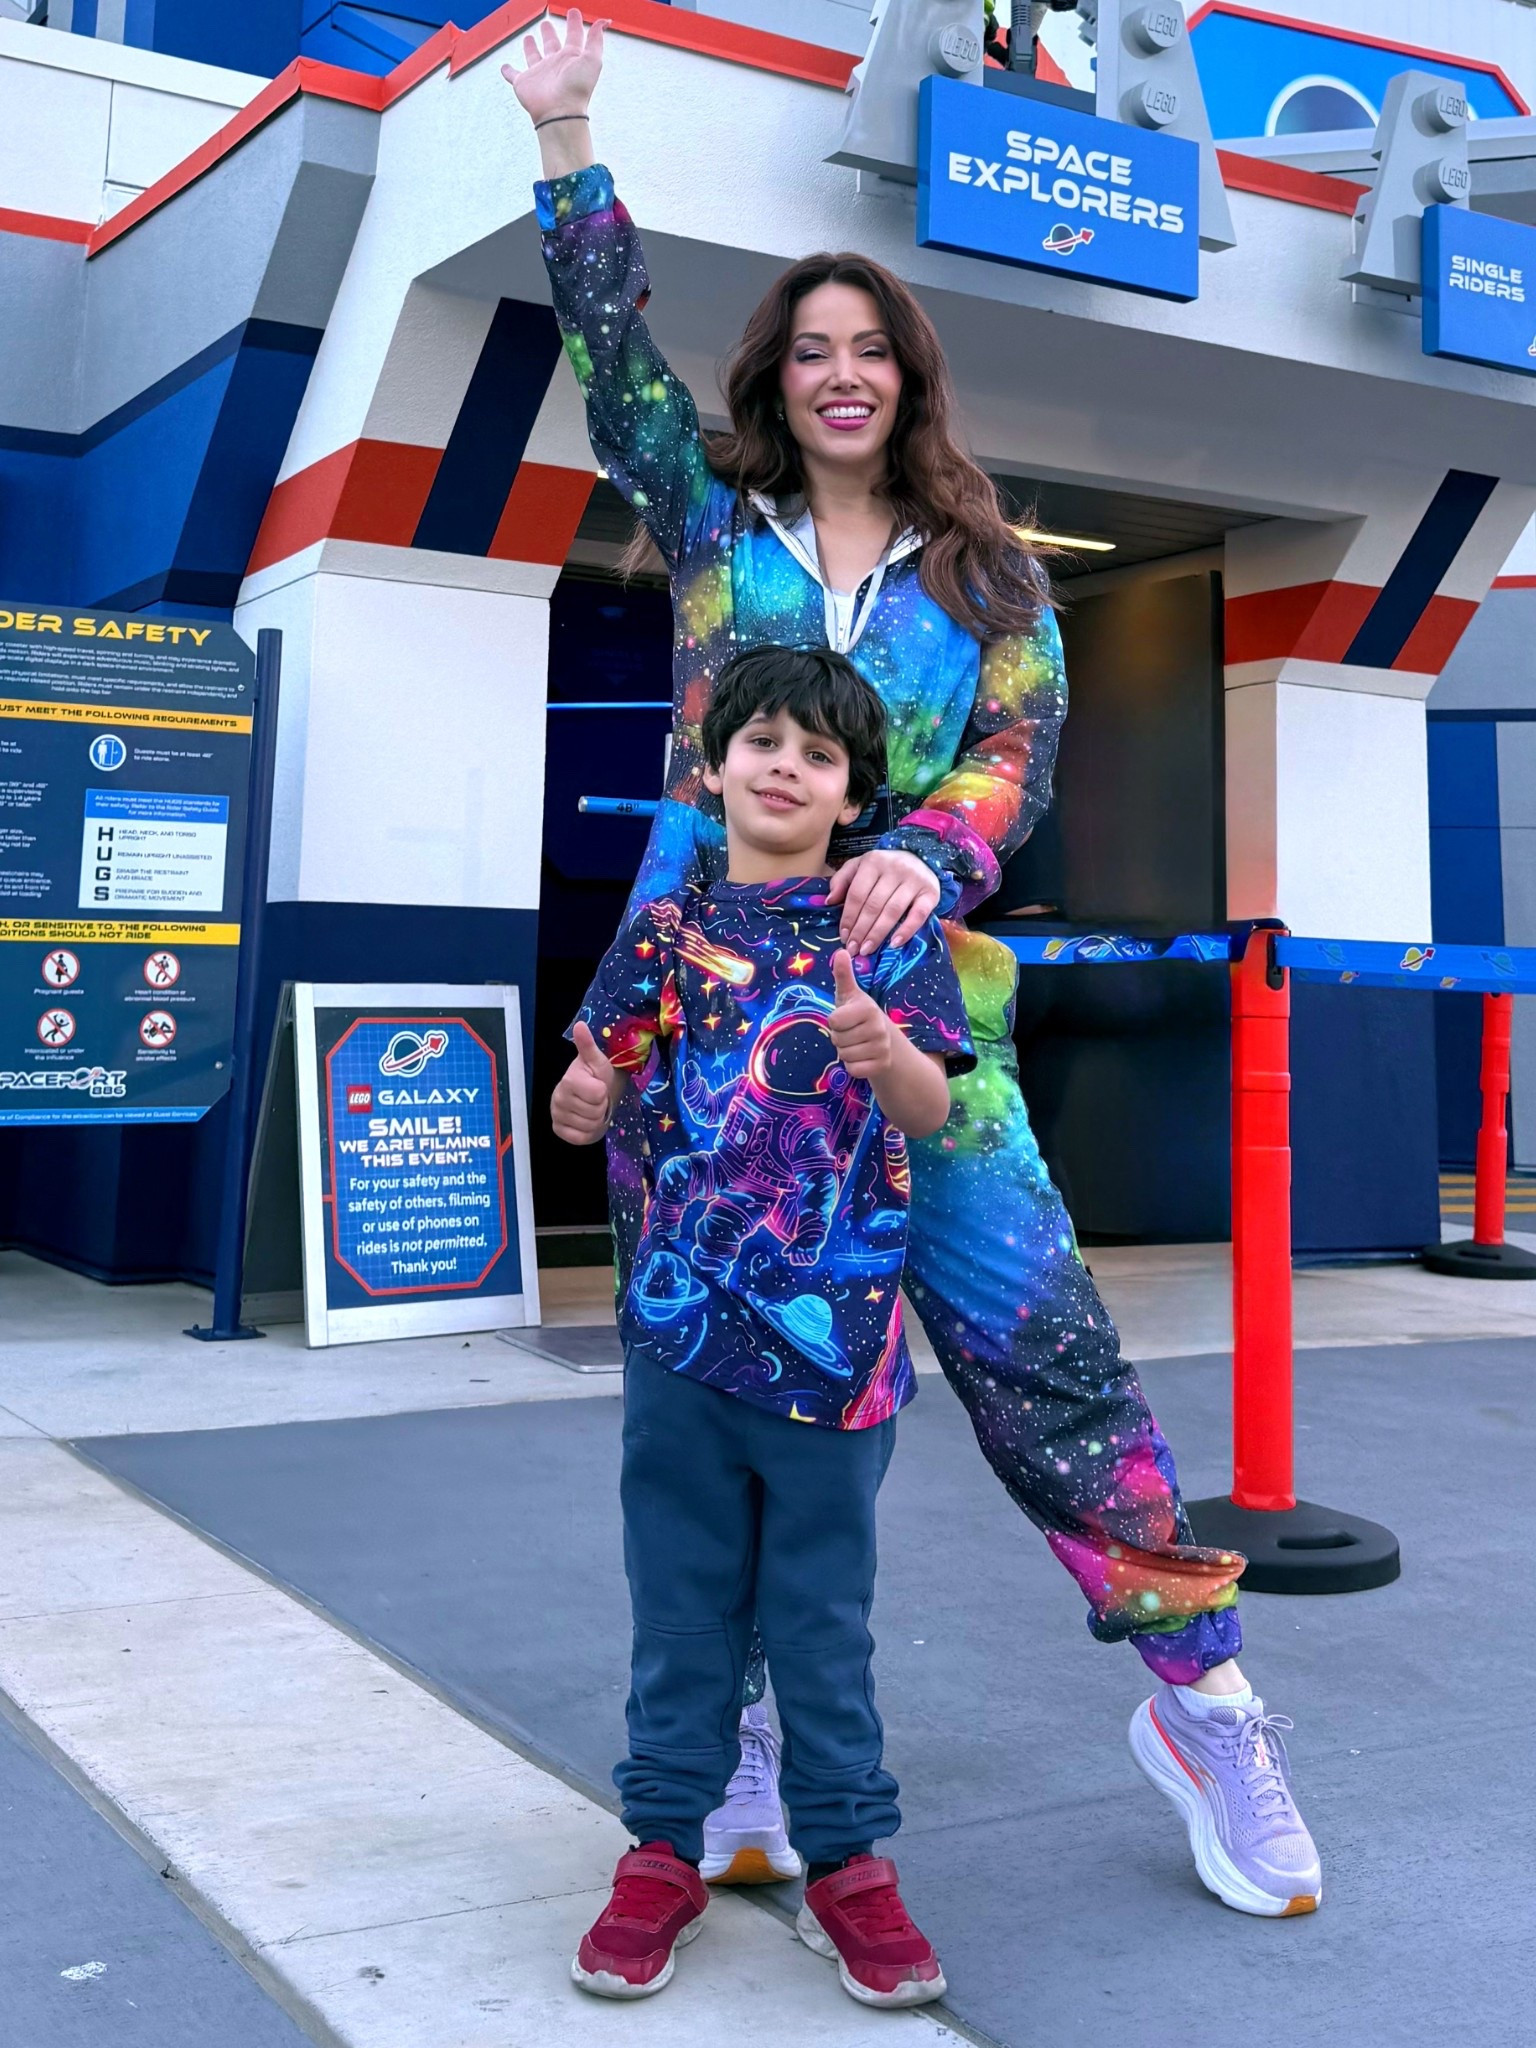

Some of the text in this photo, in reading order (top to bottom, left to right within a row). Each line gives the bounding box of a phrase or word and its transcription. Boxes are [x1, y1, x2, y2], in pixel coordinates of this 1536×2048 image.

[1148, 12, 1177, 38] LEGO
[943, 35, 979, 63] LEGO
[1146, 87, 1176, 115] LEGO
[1440, 94, 1466, 118] LEGO
[1006, 130, 1133, 187] SPACE
[1441, 166, 1468, 190] LEGO
[949, 151, 1184, 234] EXPLORERS
[1451, 254, 1523, 285] SINGLE
[1449, 272, 1526, 303] RIDERS
[0, 610, 212, 647] DER SAFETY
[0, 704, 236, 727] UST MEET THE FOLLOWING REQUIREMENTS
[97, 826, 114, 842] H
[96, 846, 113, 861] U
[95, 866, 111, 881] G
[94, 886, 110, 901] S
[34, 921, 94, 929] SENSITIVE
[142, 923, 206, 931] FOLLOWING
[49, 930, 96, 938] SHOULD
[99, 931, 122, 939] NOT
[350, 1088, 479, 1105] LEGO GALAXY
[368, 1116, 462, 1137] SMILE!
[339, 1136, 491, 1154] WE ARE FILMING
[360, 1151, 473, 1168] THIS EVENT.
[350, 1171, 487, 1193] For your safety and the
[348, 1191, 490, 1214] safety of others, filming
[362, 1215, 480, 1233] or use of phones on
[356, 1233, 487, 1255] rides is not permitted.
[391, 1256, 457, 1275] Thank you!
